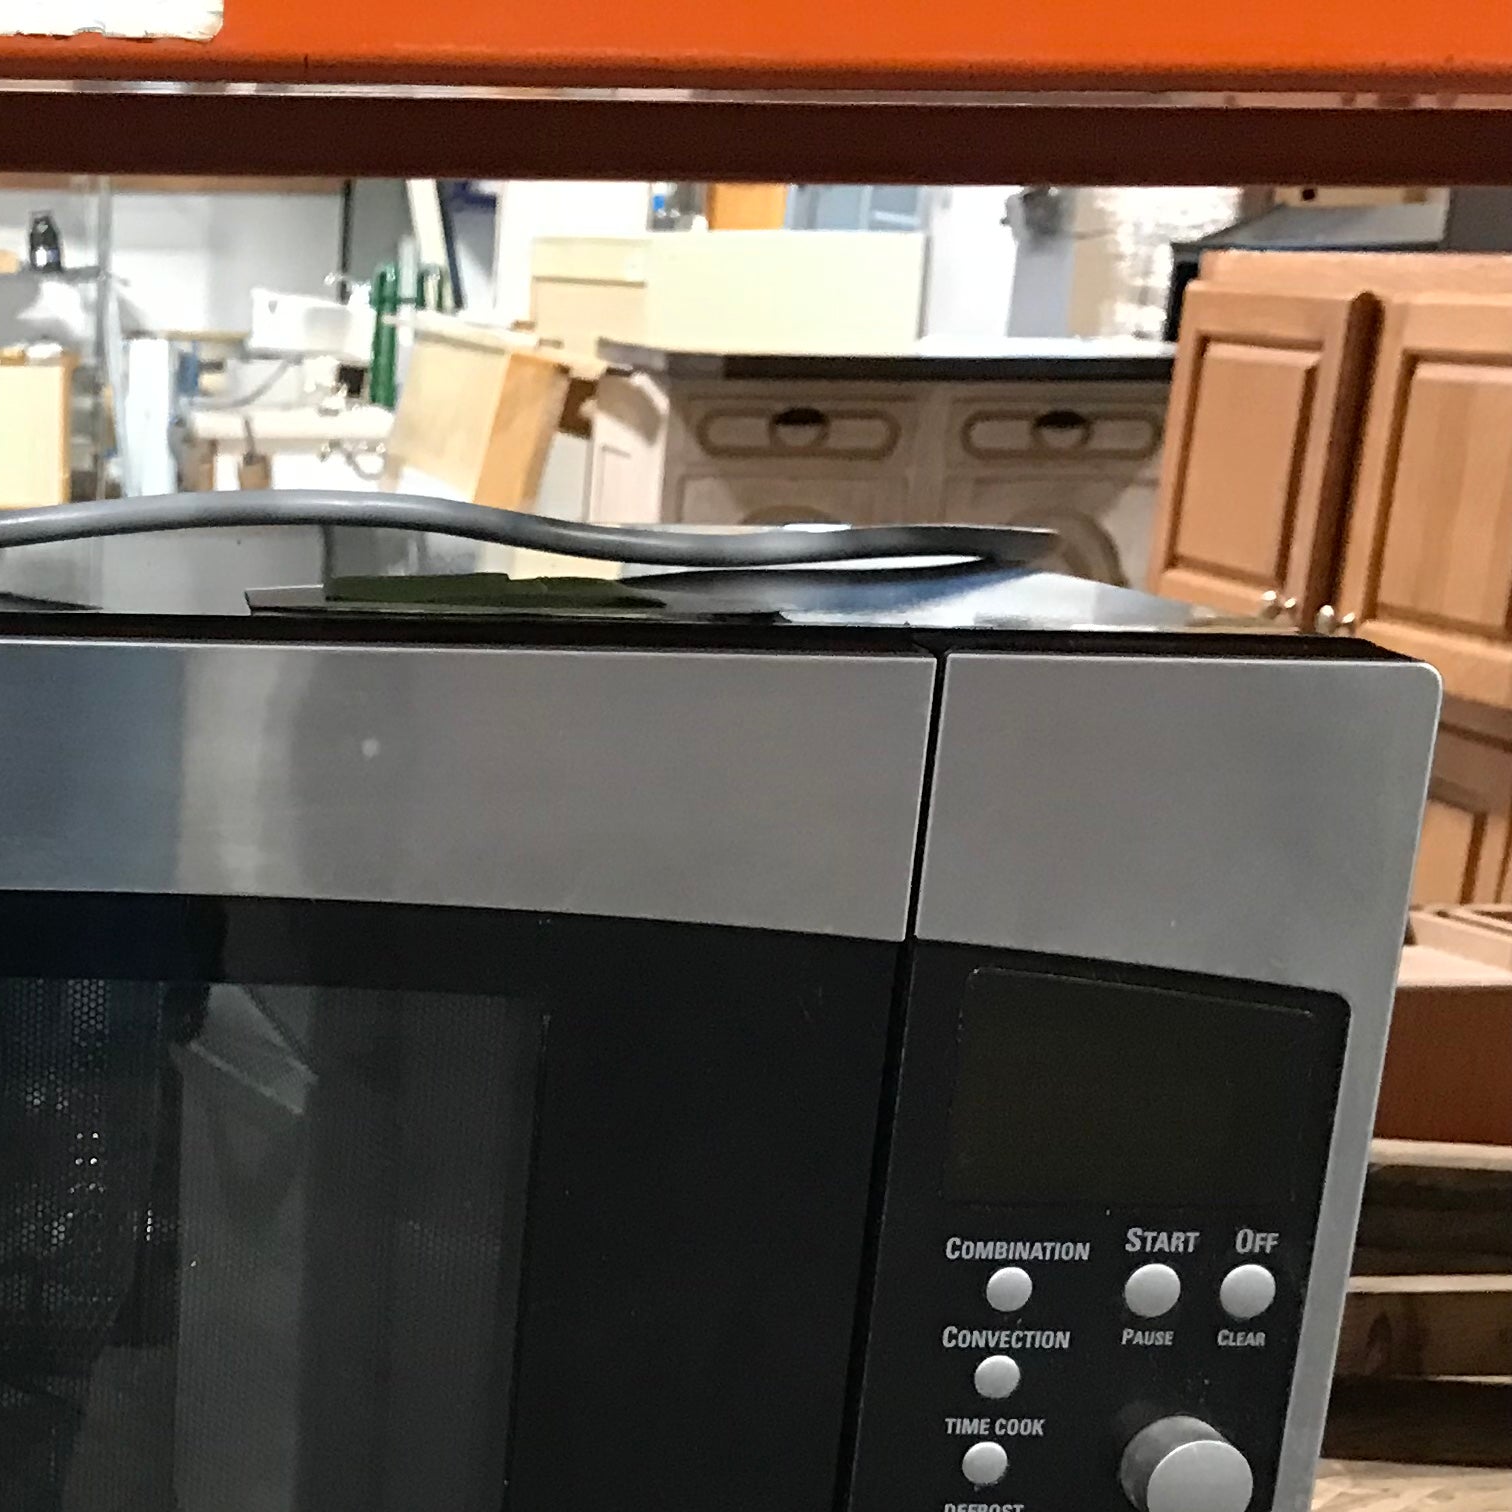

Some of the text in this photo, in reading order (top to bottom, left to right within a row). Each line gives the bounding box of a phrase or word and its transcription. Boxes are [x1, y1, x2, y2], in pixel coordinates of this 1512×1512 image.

[945, 1237, 1090, 1261] COMBINATION
[1125, 1227, 1200, 1254] START
[1235, 1228, 1279, 1254] OFF
[942, 1326, 1071, 1349] CONVECTION
[1121, 1329, 1174, 1347] PAUSE
[1217, 1329, 1266, 1347] CLEAR
[944, 1418, 1045, 1437] TIME COOK
